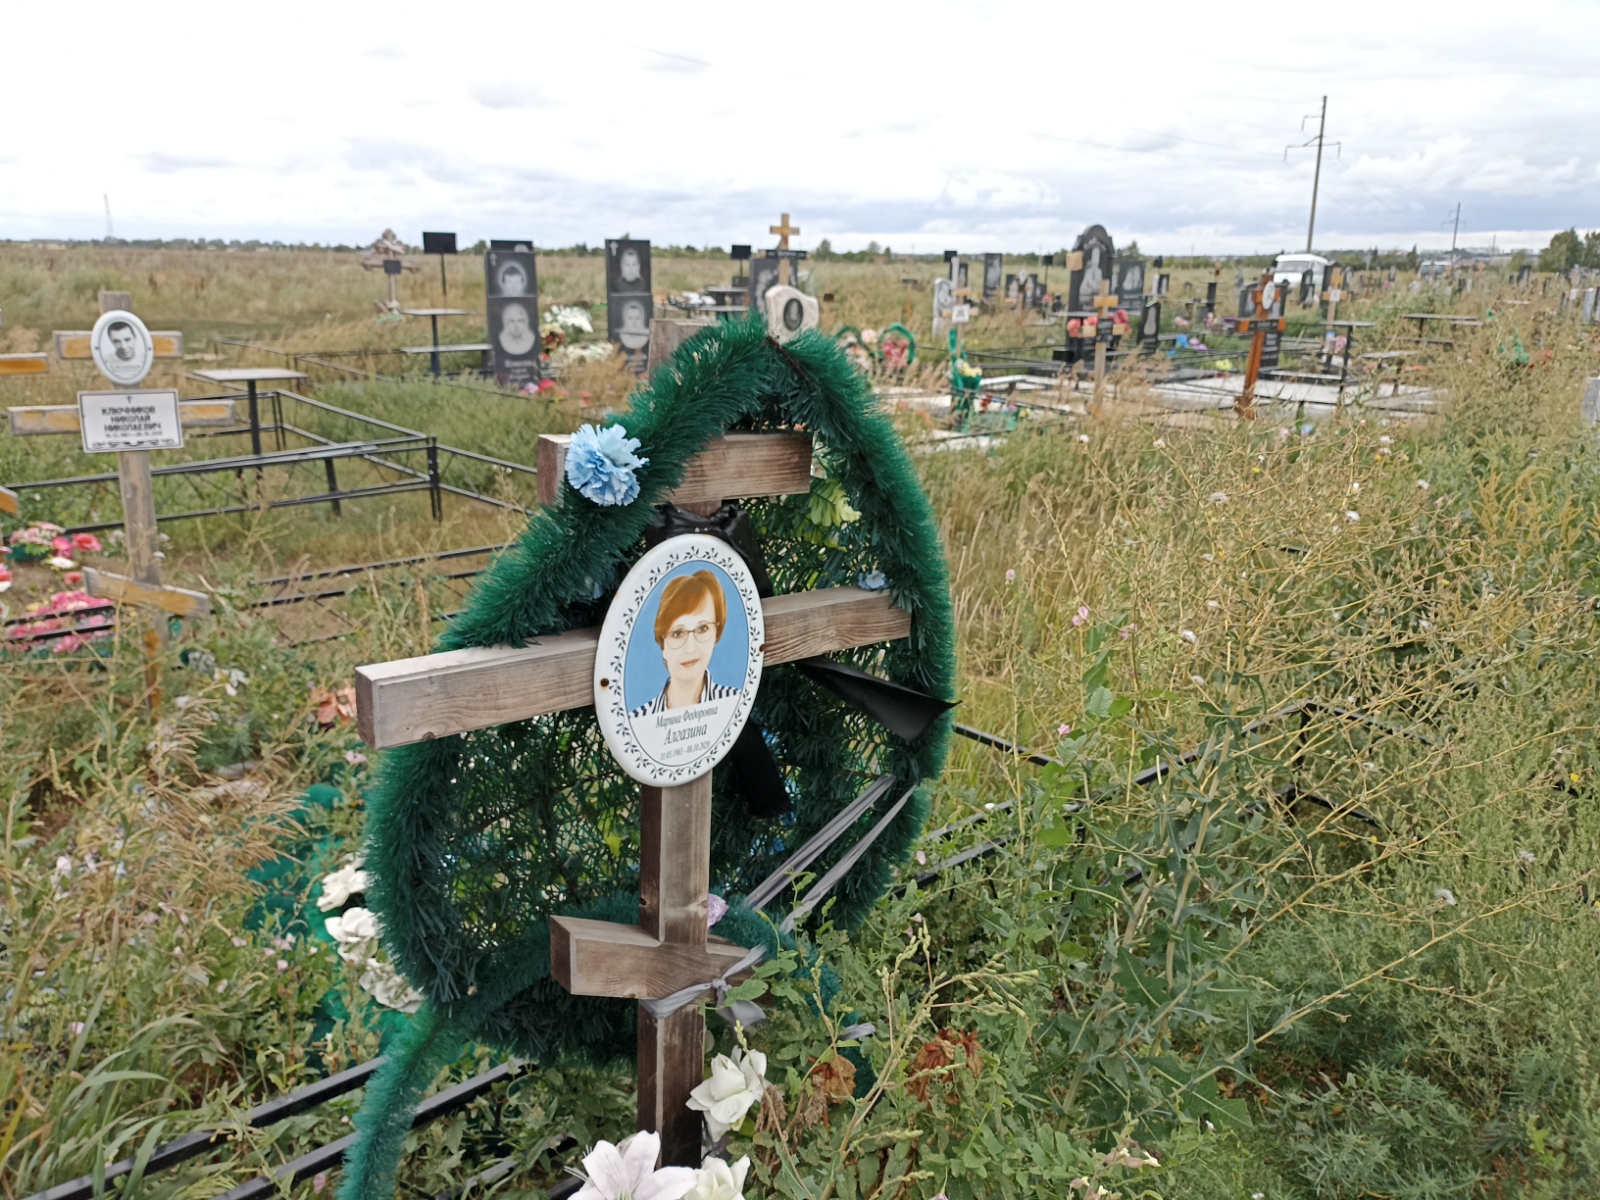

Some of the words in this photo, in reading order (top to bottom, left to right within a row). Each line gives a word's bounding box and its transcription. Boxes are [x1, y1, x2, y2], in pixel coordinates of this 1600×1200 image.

[104, 422, 161, 432] НИКОЛАЕВИЧ
[655, 715, 682, 730] Марина
[683, 707, 718, 721] Федоровна
[663, 724, 708, 745] Алгазина
